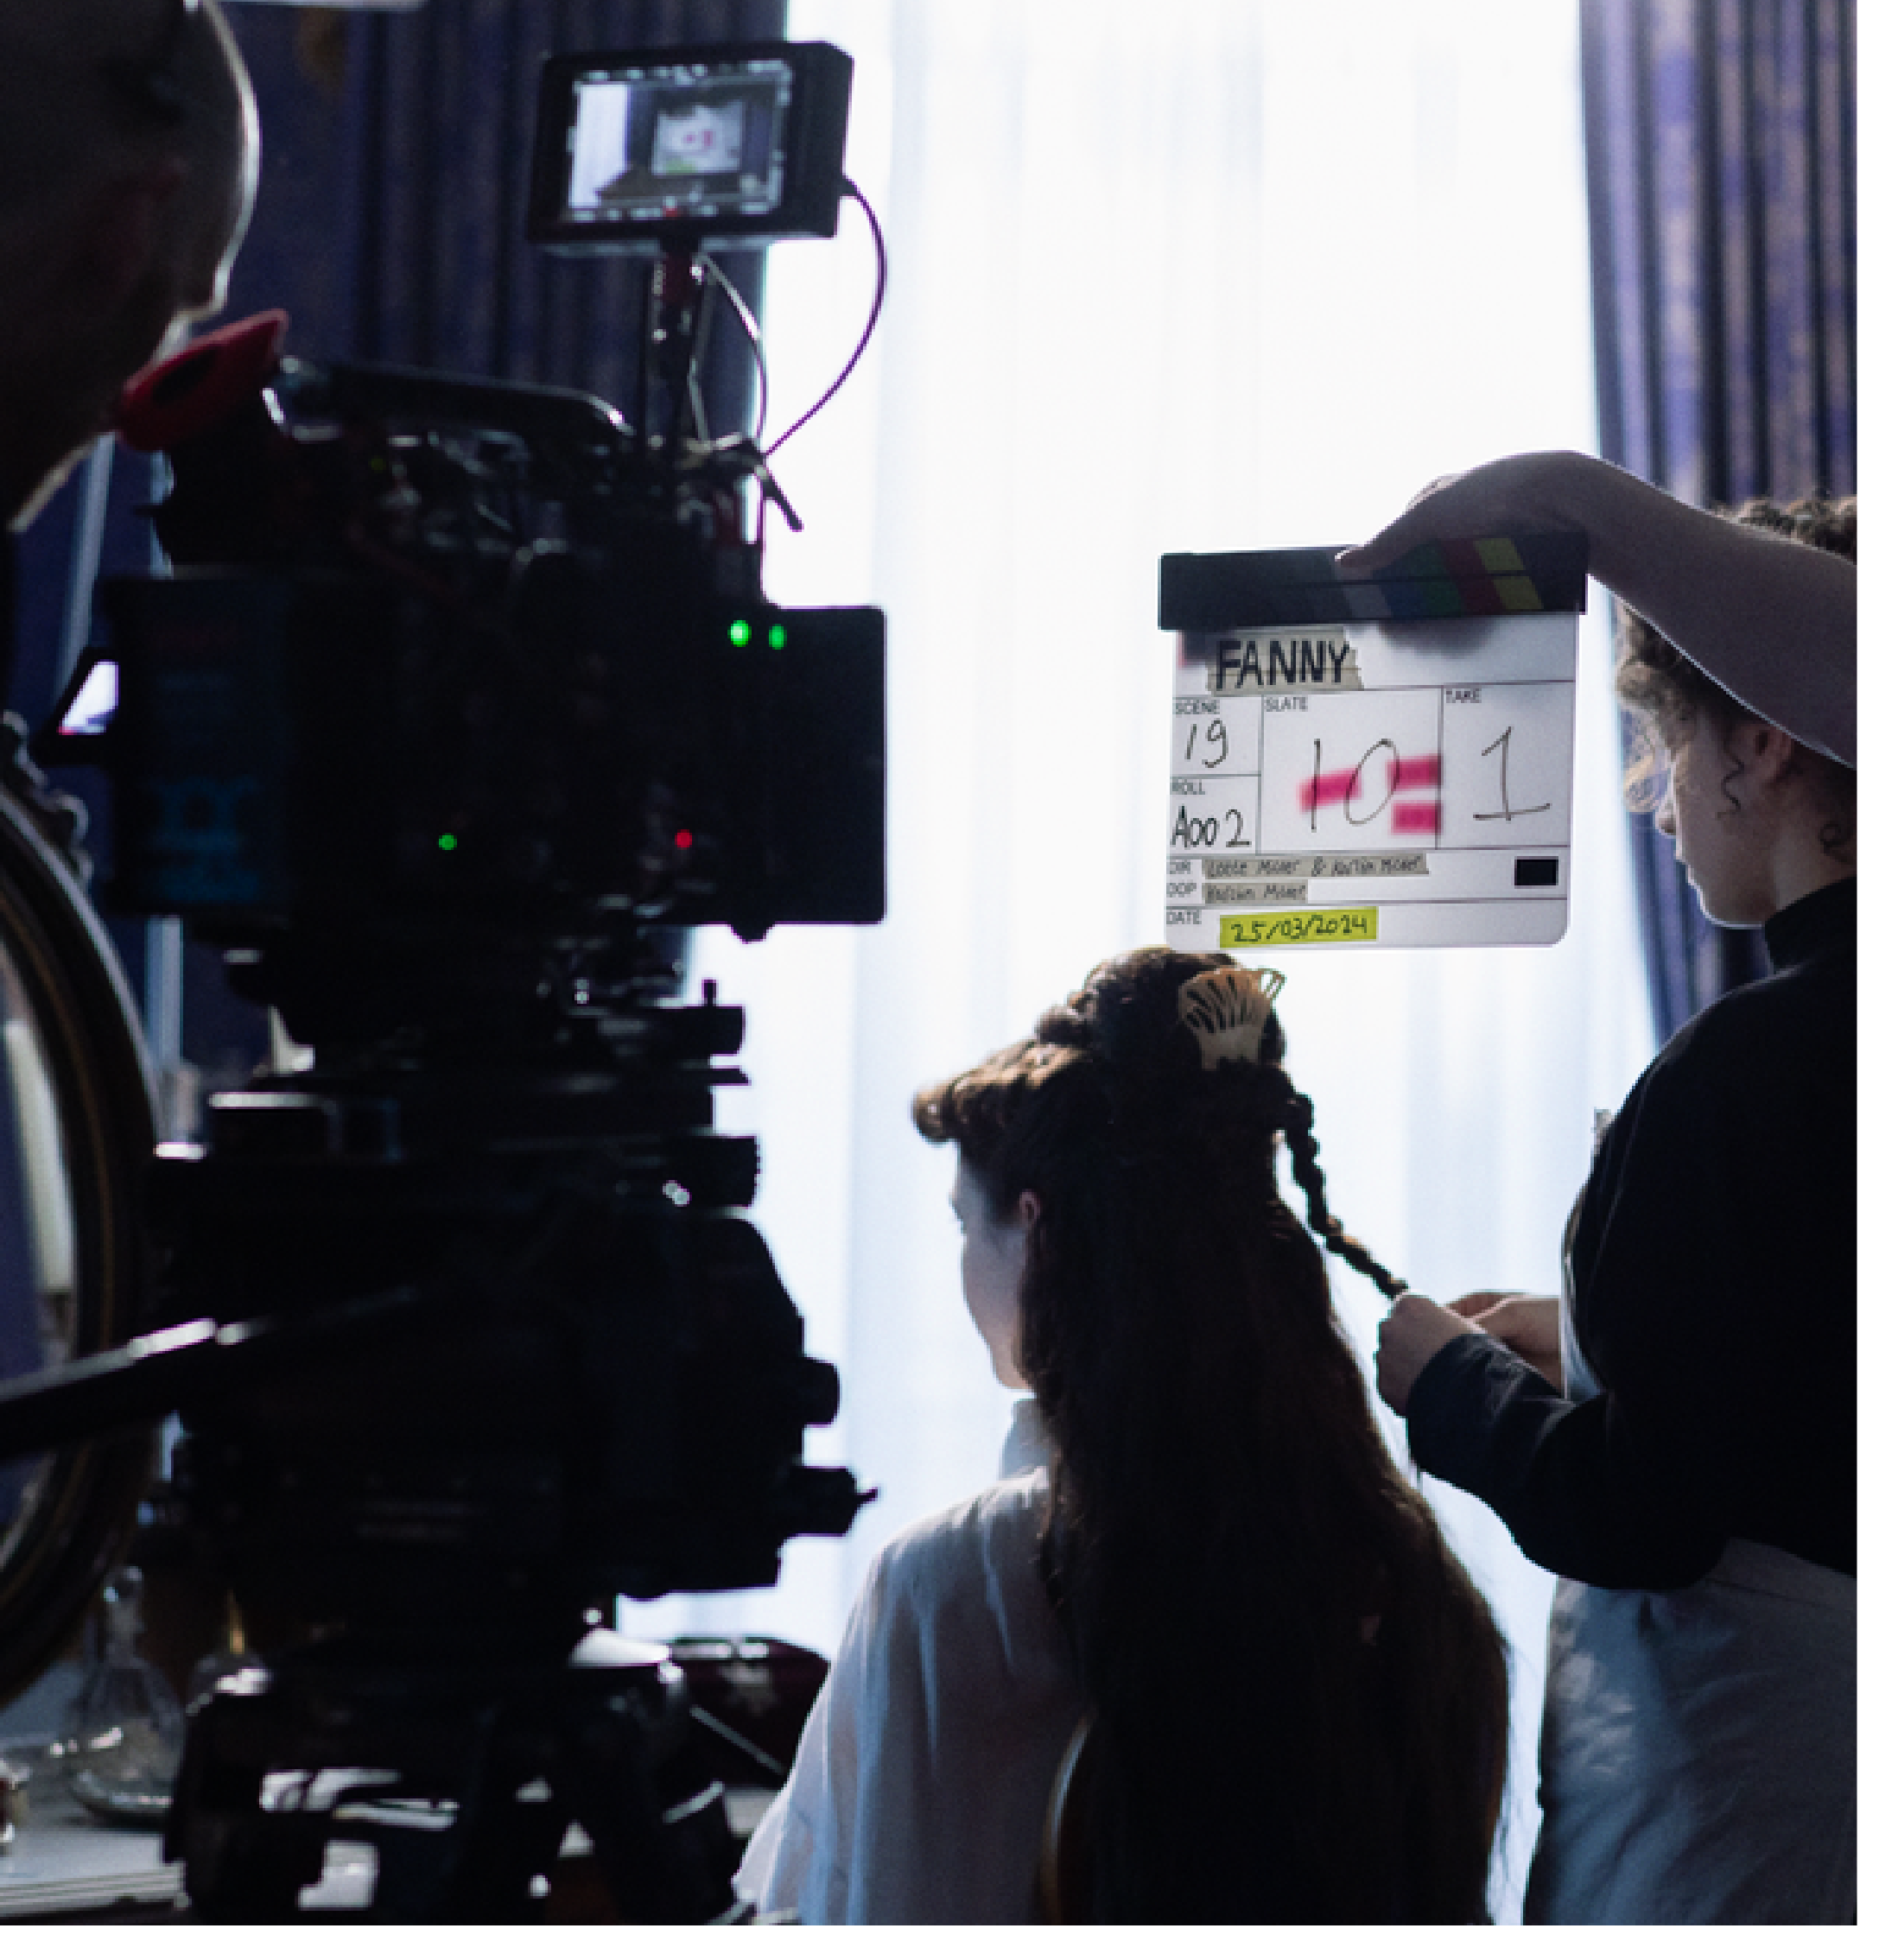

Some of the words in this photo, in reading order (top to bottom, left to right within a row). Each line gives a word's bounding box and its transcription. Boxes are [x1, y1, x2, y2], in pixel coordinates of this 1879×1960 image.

[1216, 640, 1350, 691] FANNY
[1445, 688, 1482, 703] TAKE
[1175, 698, 1220, 714] SCENE
[1265, 696, 1308, 712] SLATE
[1185, 719, 1228, 768] 19
[1473, 726, 1552, 821] 1
[1171, 780, 1206, 796] ROLL
[1310, 738, 1400, 833] 10
[1169, 859, 1191, 874] DIR
[1166, 882, 1197, 898] DOP
[1166, 910, 1202, 925] DATE
[1230, 914, 1368, 942] 25/03/2024
